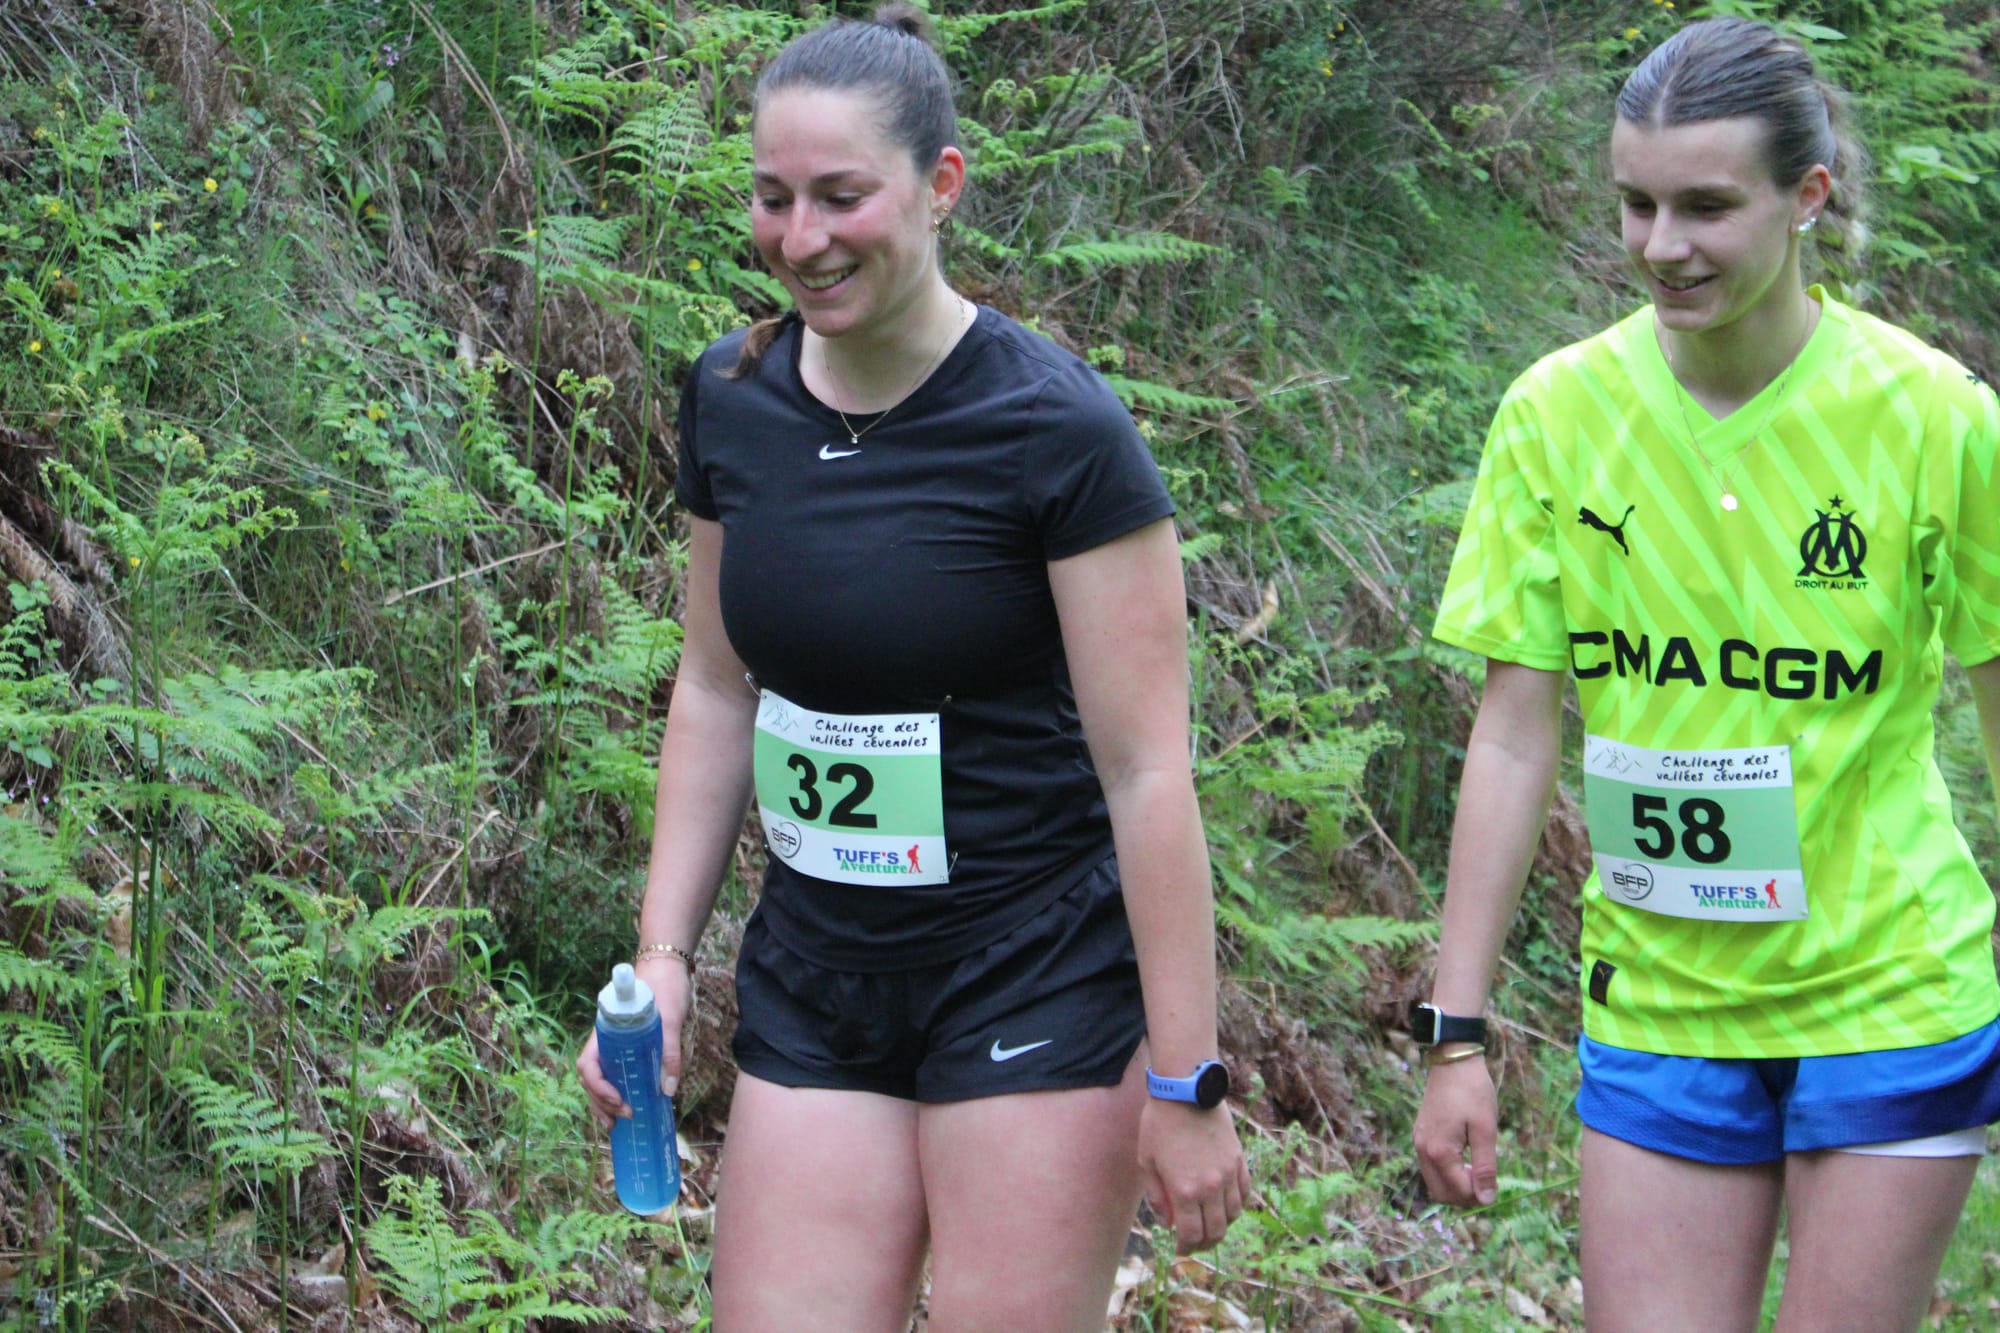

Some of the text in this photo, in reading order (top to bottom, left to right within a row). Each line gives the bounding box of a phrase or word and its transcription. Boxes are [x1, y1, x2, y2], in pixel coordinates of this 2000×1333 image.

[1795, 579, 1868, 590] DROIT AU BUT
[1568, 629, 1883, 700] CMA CGM
[815, 719, 919, 738] Challenge des
[810, 734, 928, 748] vallées cévenoles
[1662, 754, 1769, 771] Challenge des
[1656, 769, 1778, 782] vallées cévenoles
[787, 753, 878, 829] 32
[1632, 793, 1731, 864] 58
[771, 827, 797, 848] BFP
[833, 847, 899, 865] TUFF'S
[840, 858, 908, 874] Aventure
[1612, 871, 1648, 890] BFP
[1690, 884, 1757, 900] TUFF'S
[1699, 895, 1766, 908] Aventure
